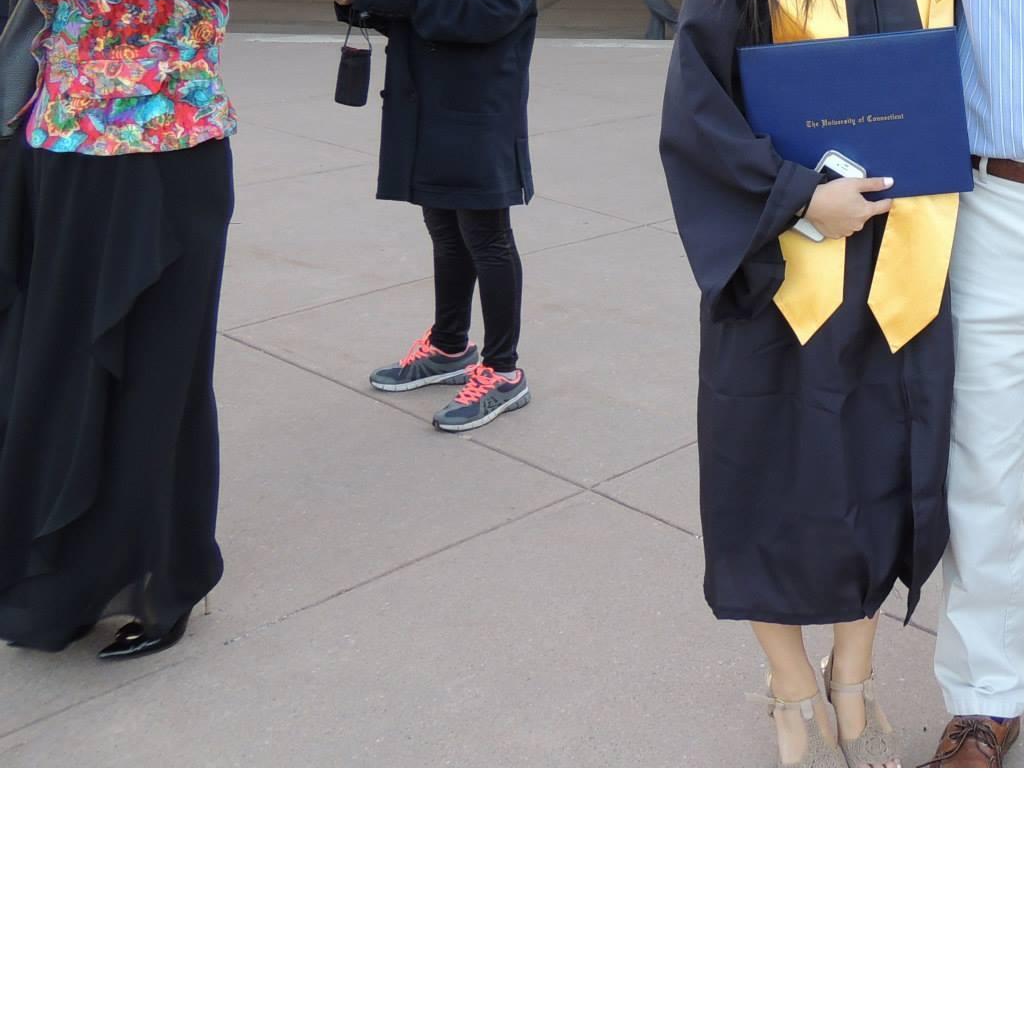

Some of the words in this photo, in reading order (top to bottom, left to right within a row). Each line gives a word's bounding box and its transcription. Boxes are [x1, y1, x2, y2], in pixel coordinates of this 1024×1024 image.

[806, 120, 819, 128] The
[821, 118, 856, 128] University
[867, 113, 904, 122] Connecticut
